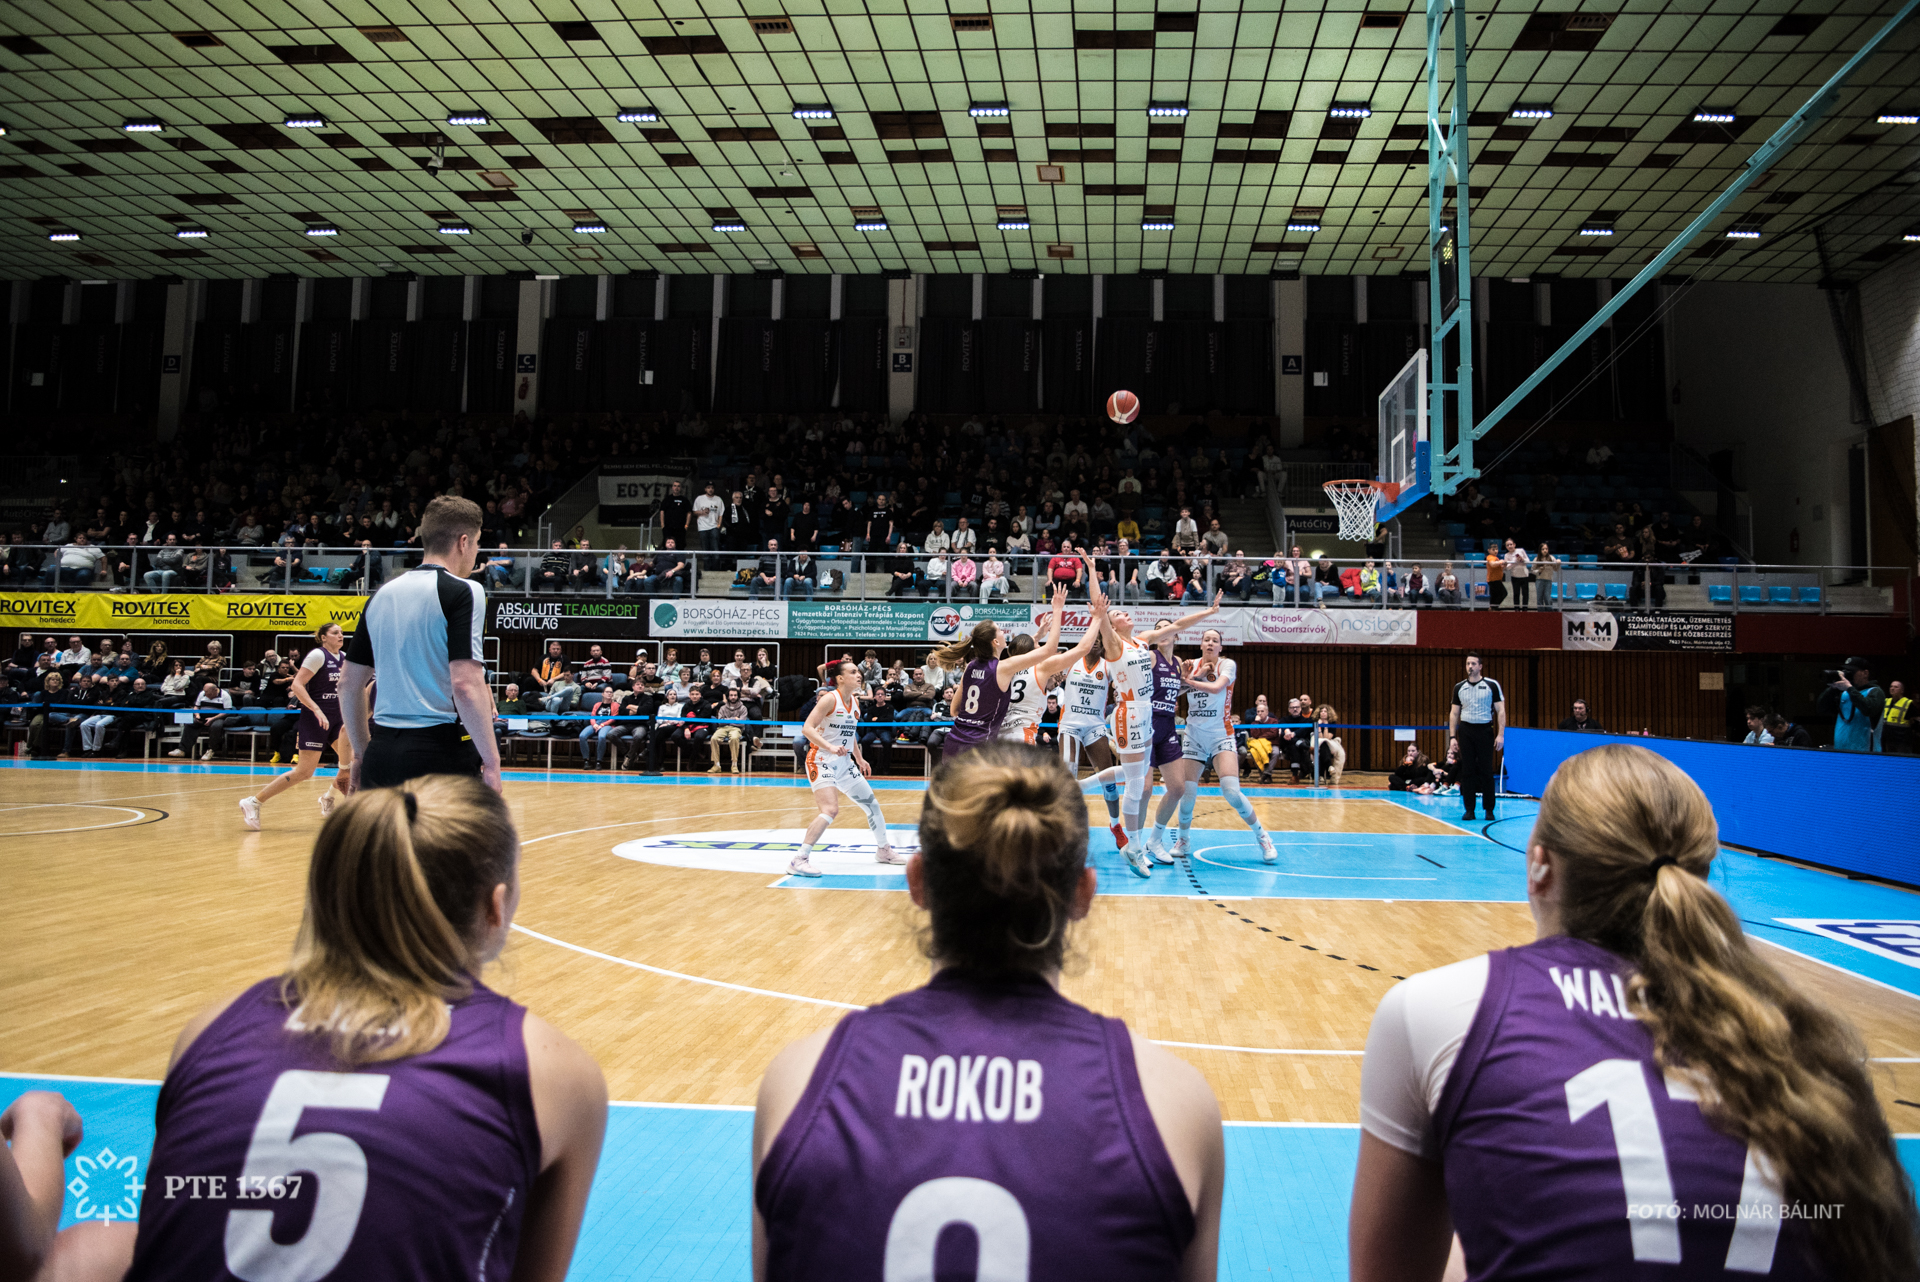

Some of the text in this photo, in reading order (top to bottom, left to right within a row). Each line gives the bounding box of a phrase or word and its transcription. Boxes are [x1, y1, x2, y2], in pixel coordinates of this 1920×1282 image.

[329, 331, 338, 372] ROVITEX
[389, 331, 399, 372] ROVITEX
[496, 329, 506, 370] ROVITEX
[575, 330, 586, 371] ROVITEX
[763, 330, 771, 372] ROVITEX
[962, 330, 970, 372] ROVITEX
[1145, 332, 1154, 373] ROVITEX
[168, 356, 177, 368] D
[523, 354, 531, 366] C
[899, 353, 906, 365] B
[1287, 357, 1297, 369] A
[1289, 518, 1333, 530] AutóCity
[0, 600, 76, 614] ROVITEX
[112, 601, 190, 615] ROVITEX
[227, 602, 306, 616] ROVITEX
[497, 602, 640, 617] ABSOLUTE TEAMSPORT
[683, 606, 780, 620] BORSÓHÁZ-PÉCS
[824, 604, 892, 612] BORSÓHÁZ-PÉCS
[974, 606, 1029, 615] BORSÓHÁZ-PÉCS
[39, 616, 76, 624] homedeco
[153, 617, 190, 625] homedeco
[792, 610, 833, 618] Nemzetközi
[864, 611, 893, 620] Terápiás
[894, 612, 925, 620] Központ
[1270, 614, 1303, 624] bajnok
[1627, 615, 1688, 624] SZOLGÁLTATÁSOK,
[496, 617, 559, 630] FOCIVILÁG
[1261, 624, 1327, 634] babaorrszívók
[1341, 616, 1412, 631] nosiboo
[1670, 622, 1678, 630] ÉS
[683, 627, 780, 636] www.borsohazpecs.hu
[965, 684, 980, 715] 8
[1080, 696, 1091, 706] 14
[1165, 689, 1178, 701] 32
[1197, 700, 1207, 708] 15
[1130, 732, 1141, 741] 21
[895, 1054, 1044, 1123] ROKOB
[1564, 1058, 1783, 1274] 17
[223, 1069, 391, 1282] 5
